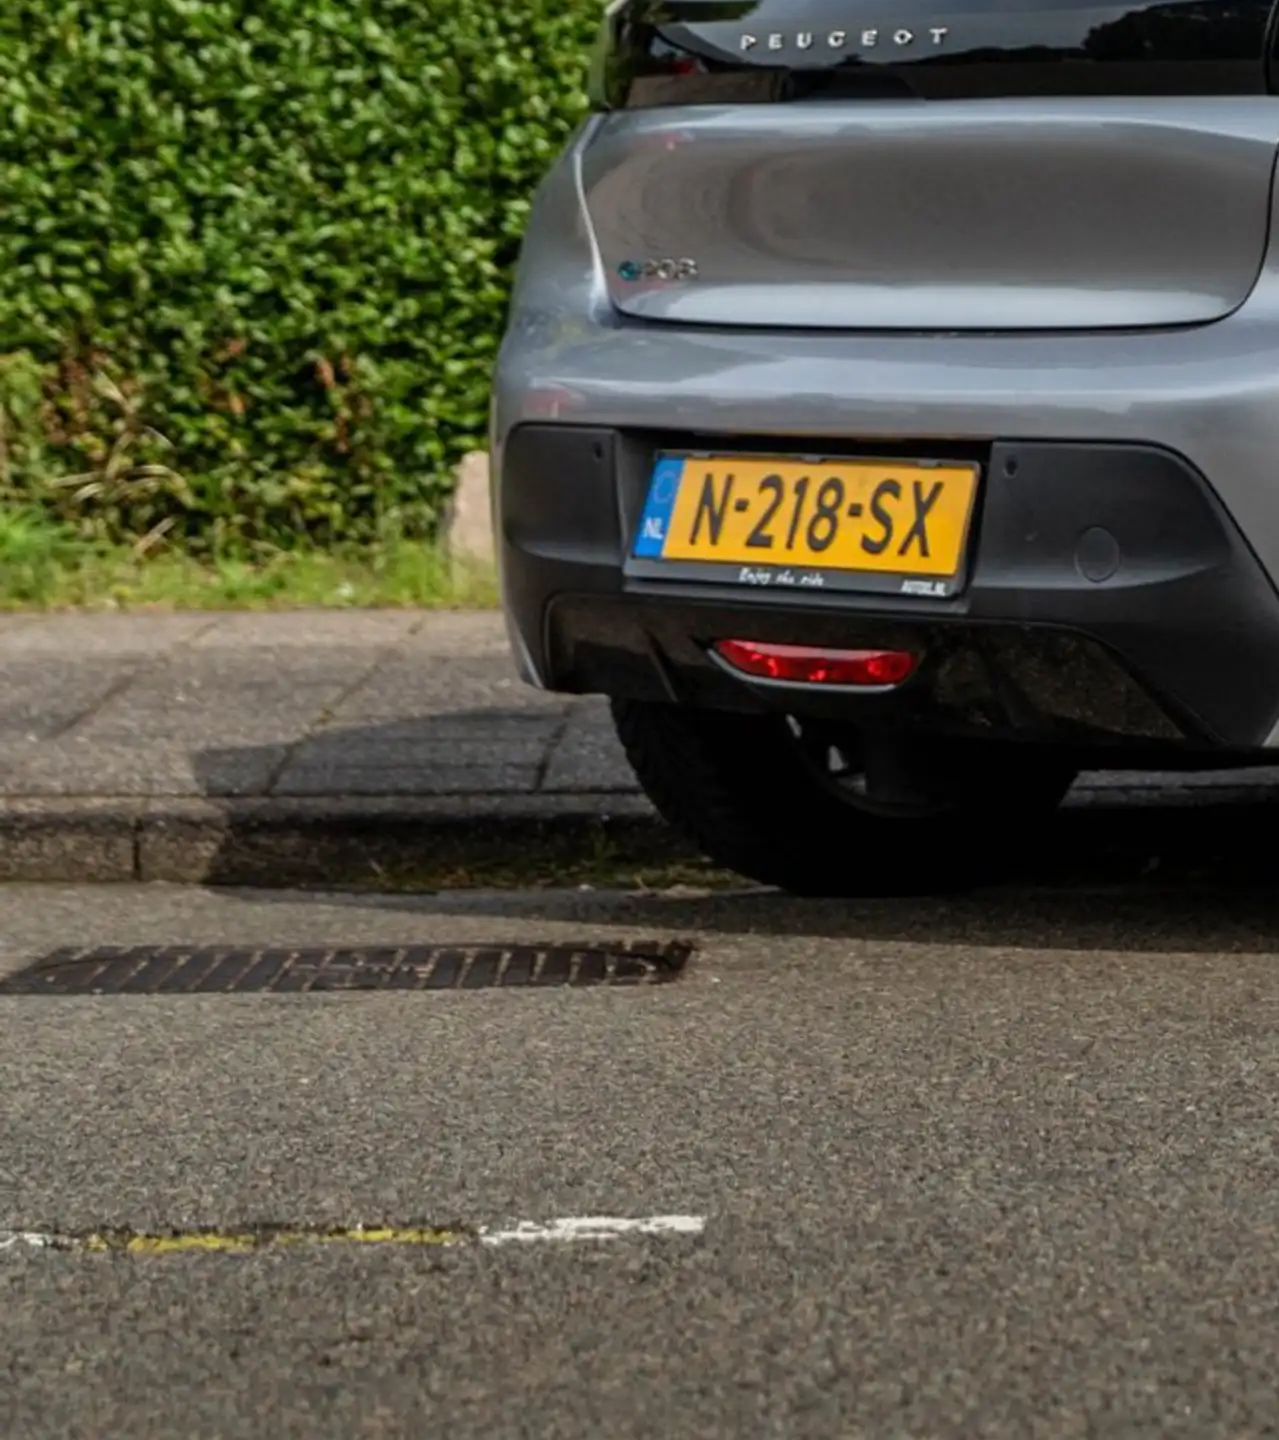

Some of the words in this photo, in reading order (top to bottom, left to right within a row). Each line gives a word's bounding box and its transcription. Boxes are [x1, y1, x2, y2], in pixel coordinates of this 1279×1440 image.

[740, 27, 948, 51] PEUGEOT
[689, 472, 945, 558] N-218-SX
[641, 516, 663, 540] NL
